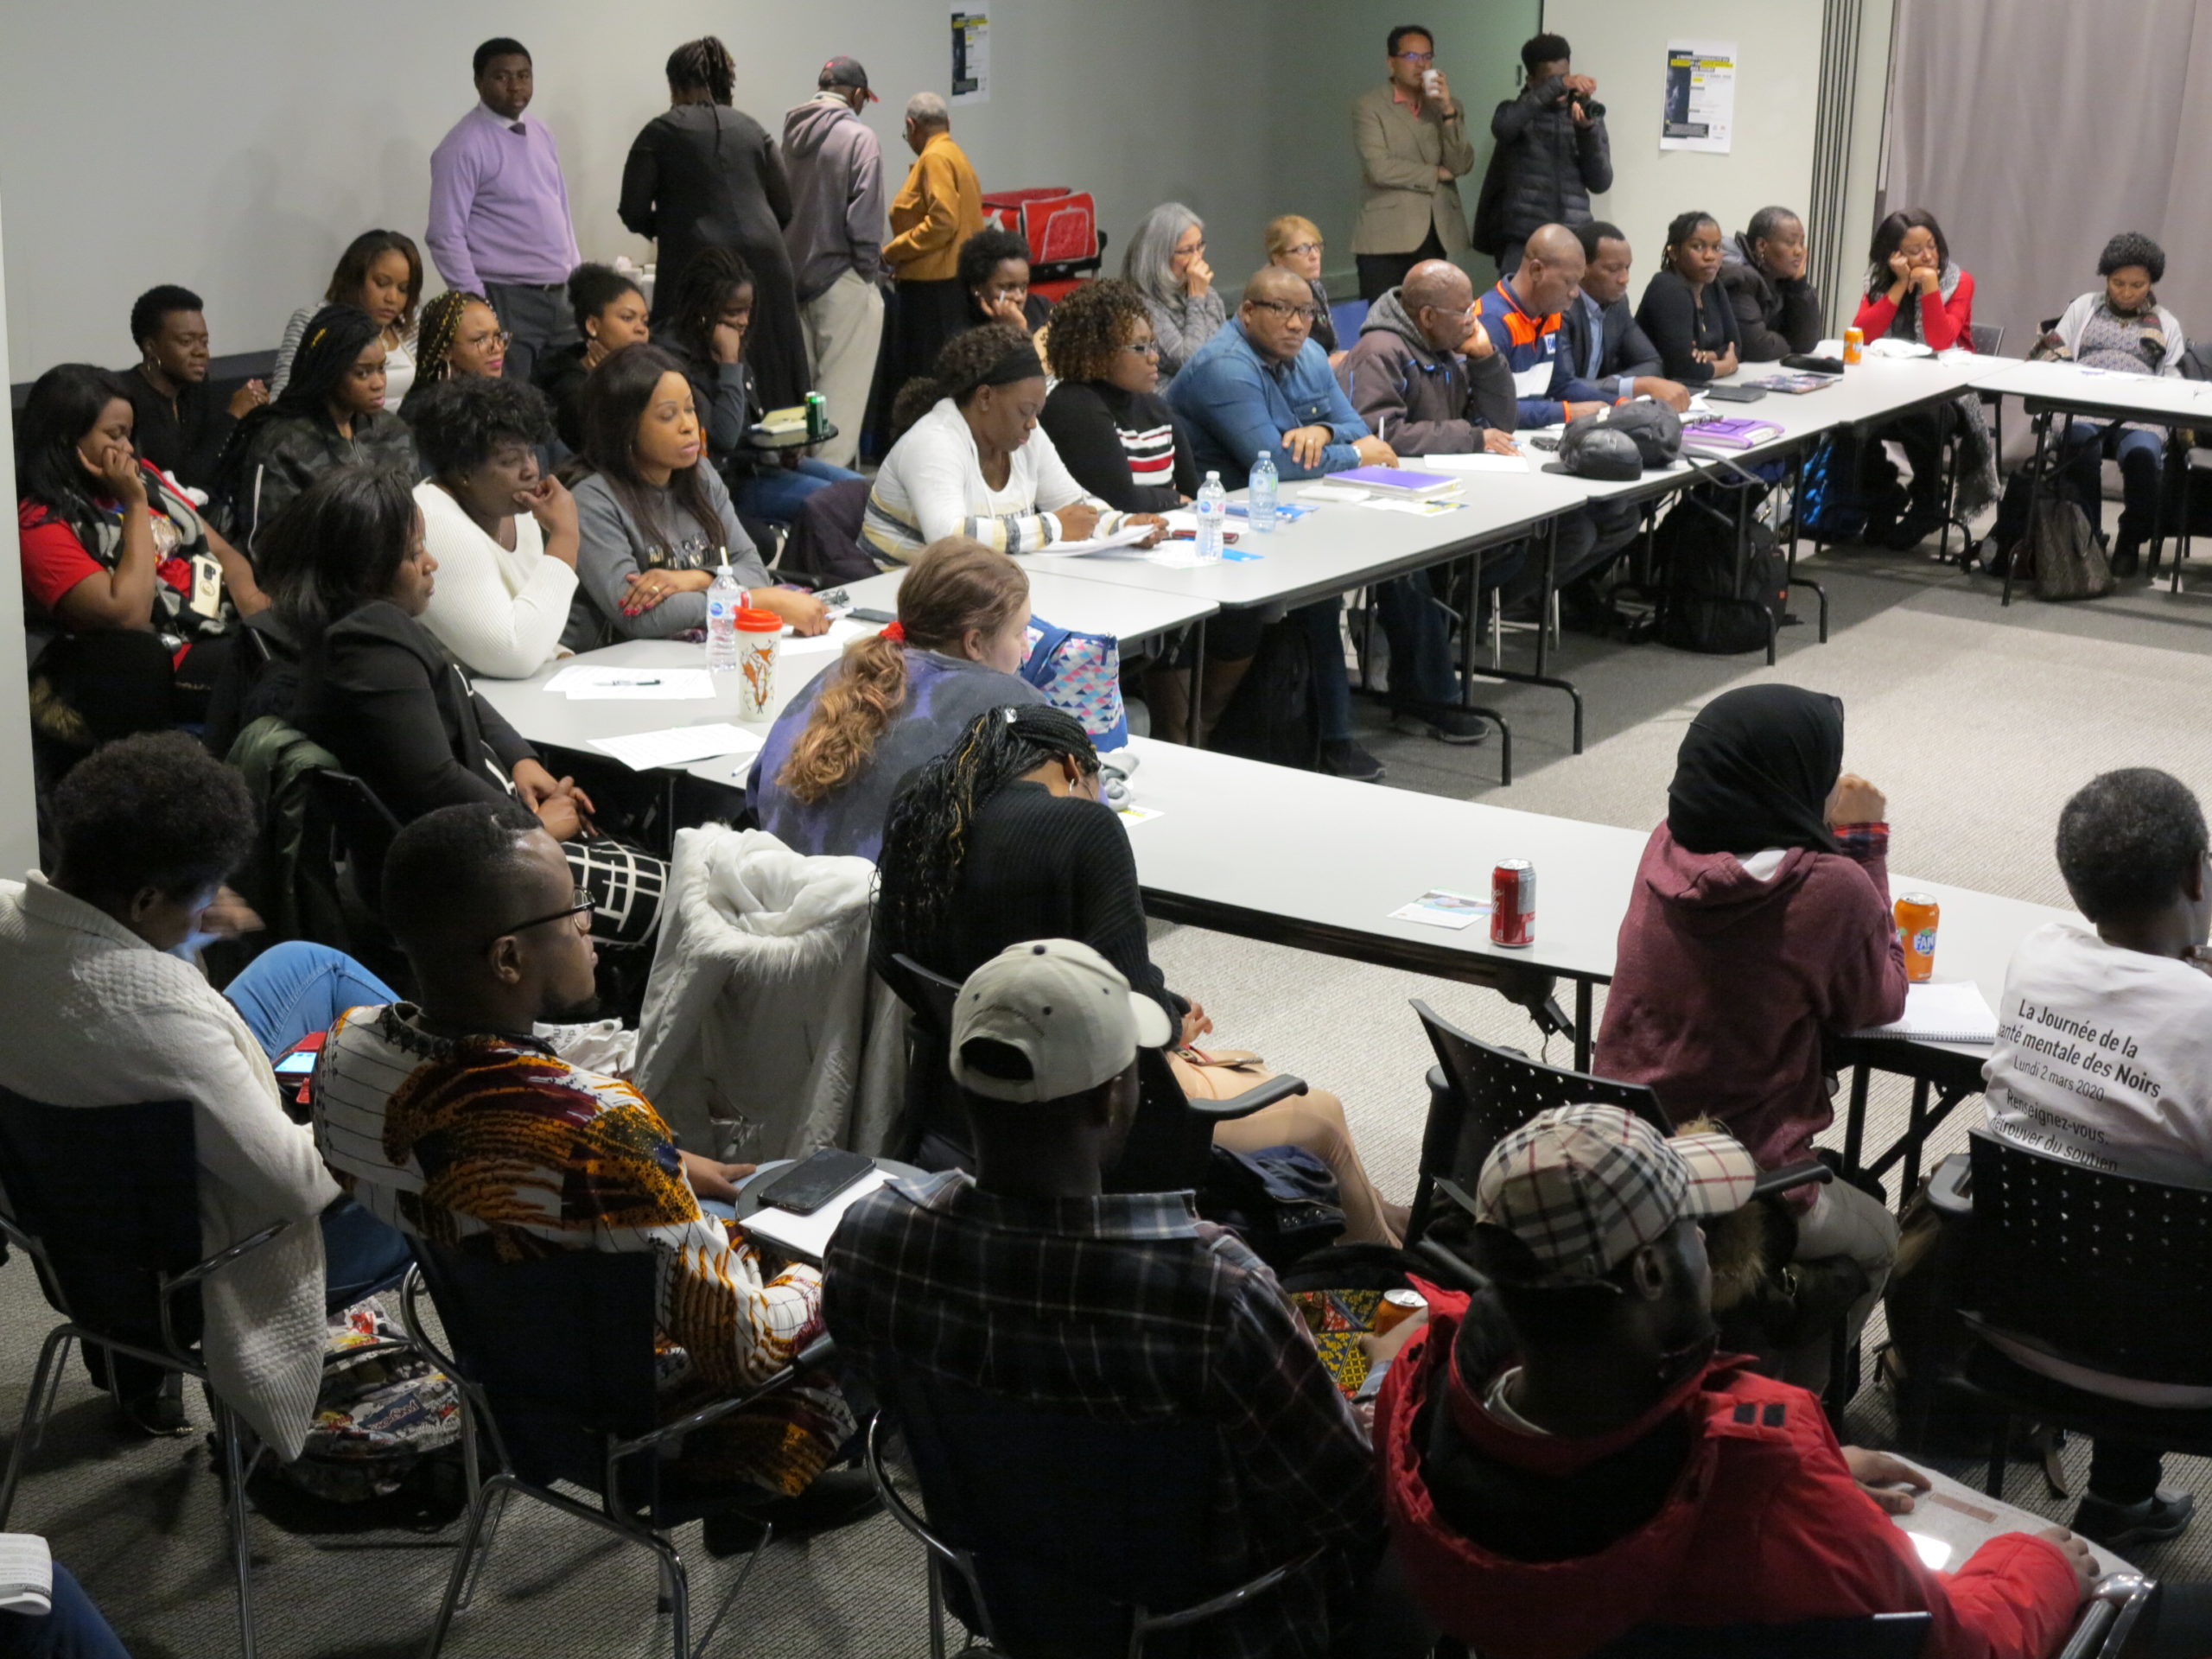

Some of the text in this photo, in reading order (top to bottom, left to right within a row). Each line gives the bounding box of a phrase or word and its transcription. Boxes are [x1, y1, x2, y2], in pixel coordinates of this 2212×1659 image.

[2018, 999, 2139, 1058] La Journée de la
[2013, 1054, 2105, 1103] Lundi 2 mars 2020
[2023, 1033, 2081, 1065] mentale
[2082, 1052, 2113, 1077] des
[2114, 1064, 2161, 1098] Noirs
[2006, 1088, 2109, 1146] Renseignez-vous.
[2044, 1134, 2063, 1154] du
